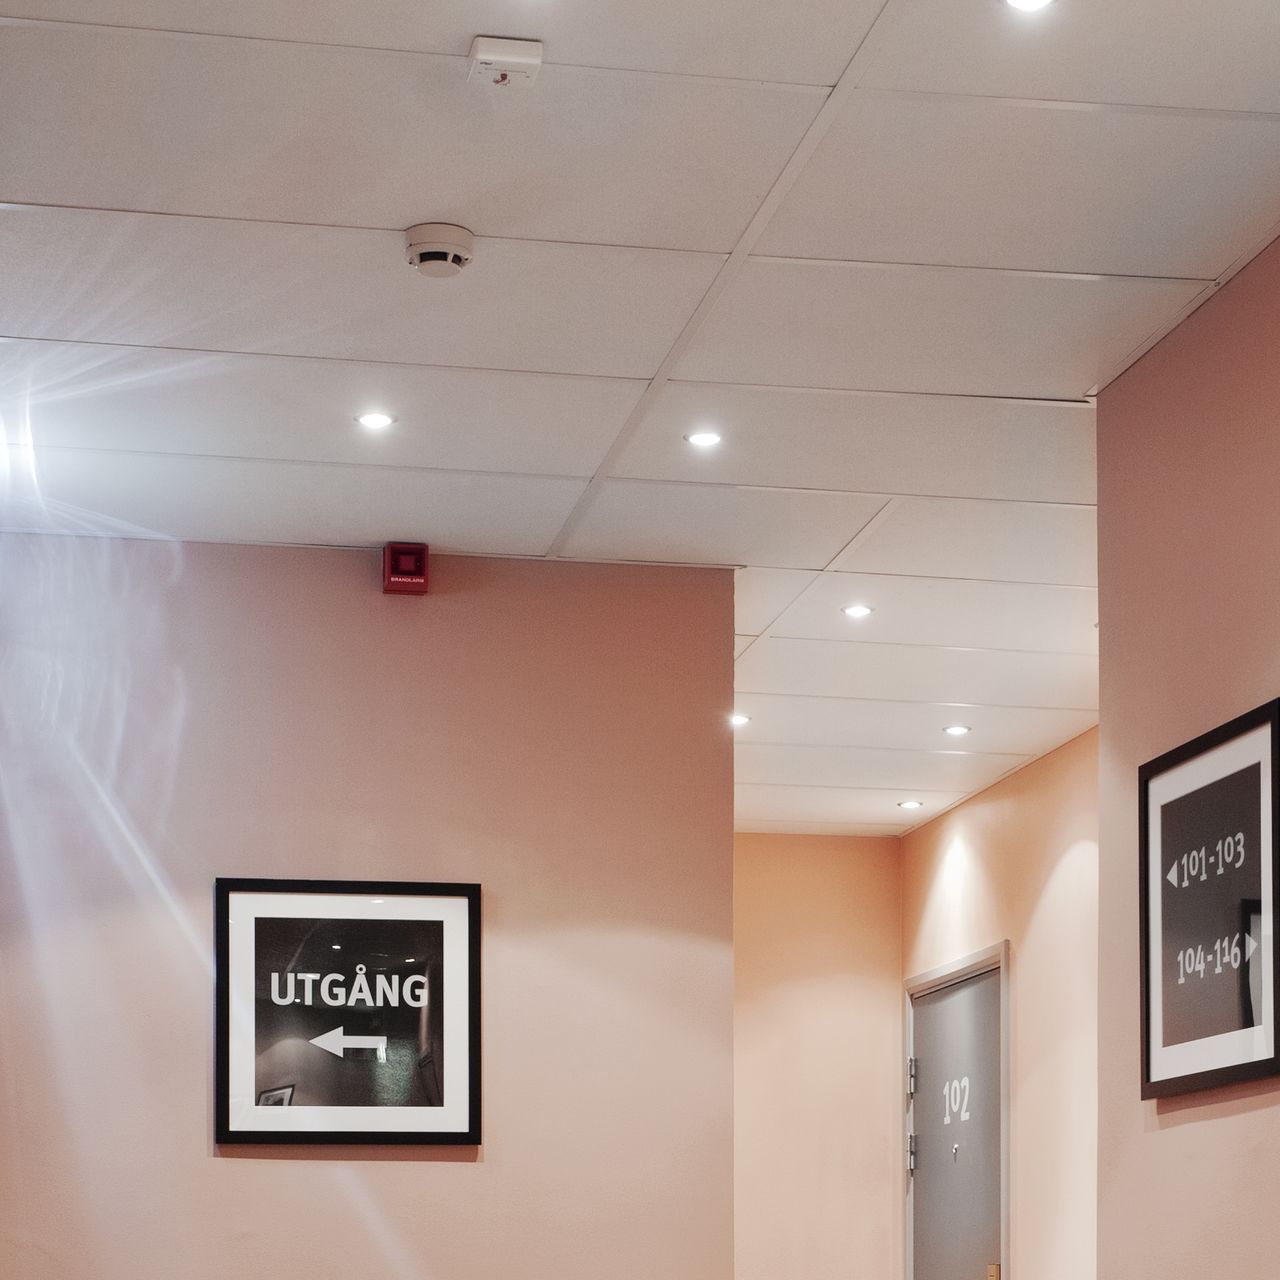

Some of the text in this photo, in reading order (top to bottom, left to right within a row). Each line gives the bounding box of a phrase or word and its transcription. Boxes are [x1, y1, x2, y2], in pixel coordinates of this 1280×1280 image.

[1181, 831, 1245, 888] 101-103
[1177, 932, 1241, 985] 104-116
[270, 964, 429, 1008] UTGÅNG
[943, 1076, 970, 1125] 102
